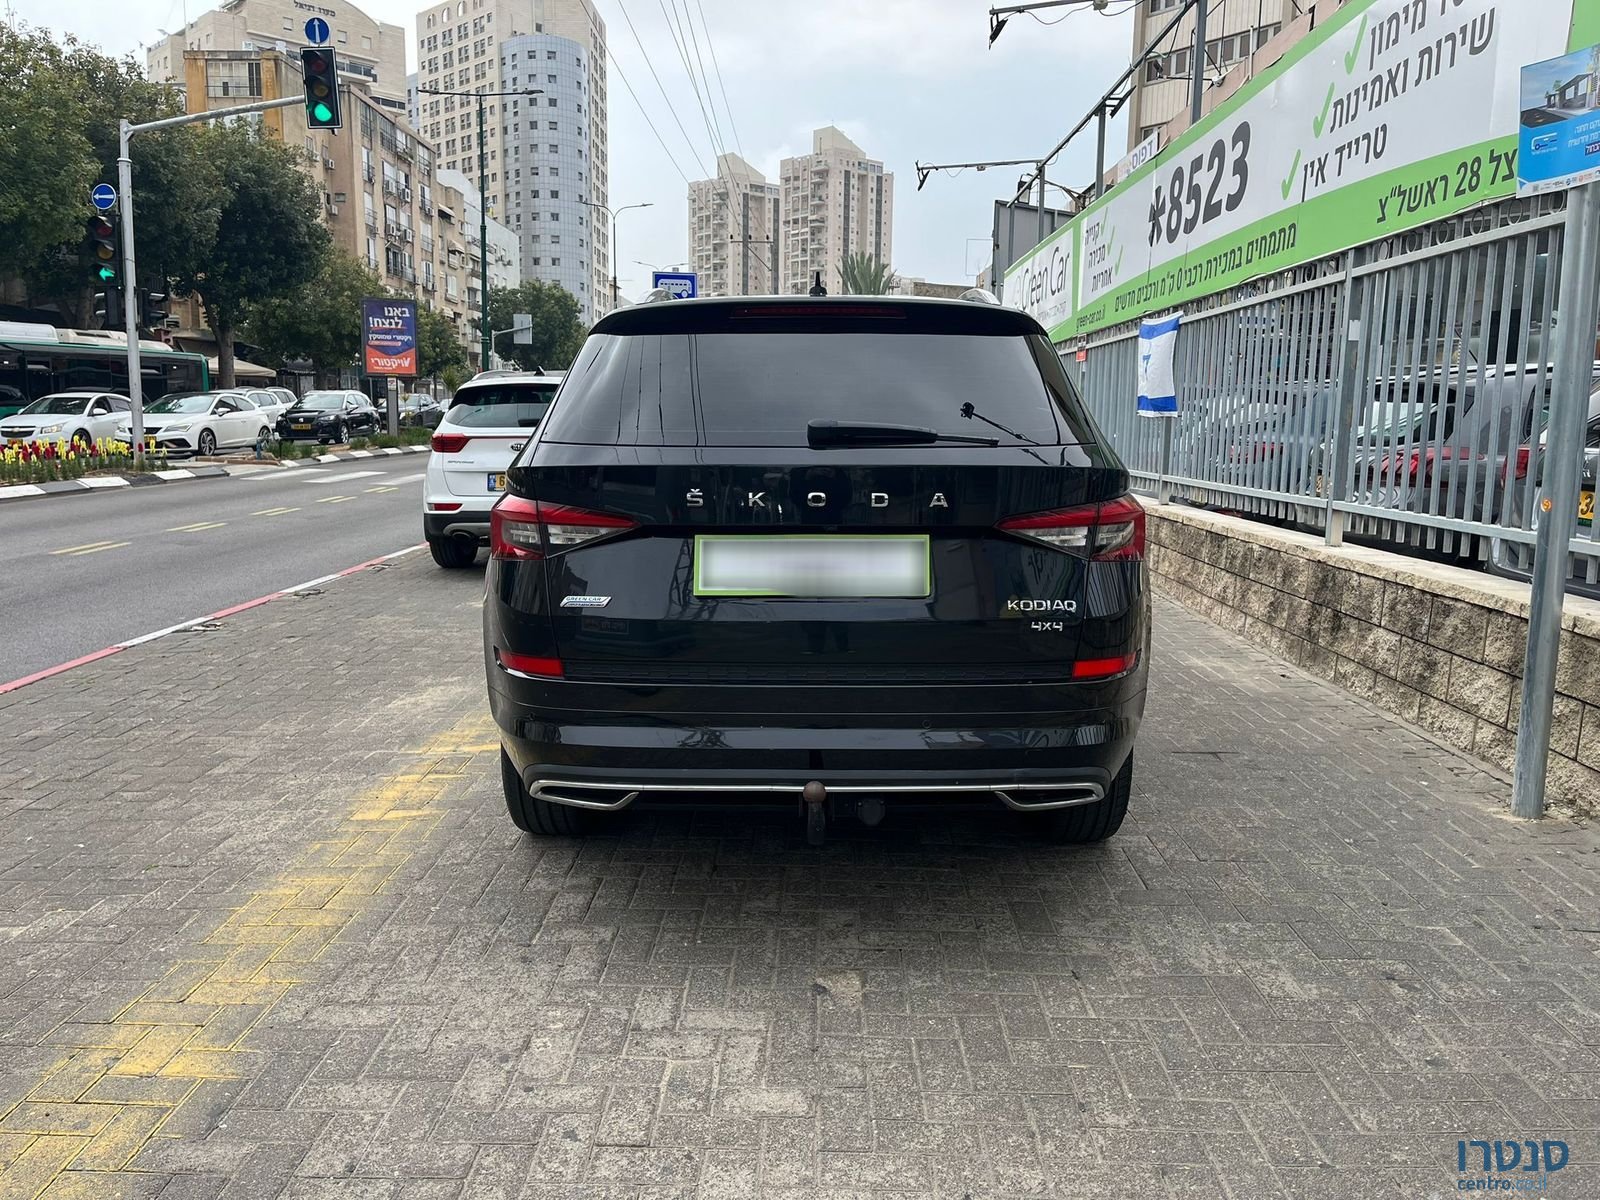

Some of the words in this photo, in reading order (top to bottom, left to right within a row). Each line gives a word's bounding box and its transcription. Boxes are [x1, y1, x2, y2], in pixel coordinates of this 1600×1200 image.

[1369, 0, 1427, 71] מימון
[1414, 7, 1496, 88] שירות
[1329, 57, 1409, 133] ואמינות
[1132, 139, 1153, 169] דפוס
[1334, 123, 1388, 177] טרייד
[1301, 152, 1329, 203] אין
[1454, 156, 1483, 198] 28
[1488, 148, 1518, 186] צל
[1088, 243, 1106, 269] מכירה
[1245, 222, 1297, 264] מתמחים
[1021, 265, 1049, 311] Green
[1050, 246, 1070, 296] Car
[1091, 266, 1113, 292] אחריות
[1176, 267, 1183, 292] 0
[1184, 263, 1203, 288] רכבי
[1204, 248, 1243, 282] במכירת
[1114, 288, 1135, 313] חדשים
[1136, 280, 1159, 305] ורכבים
[369, 316, 403, 328] לנצח!
[384, 306, 411, 317] באנו
[1007, 599, 1077, 613] KODIAQ
